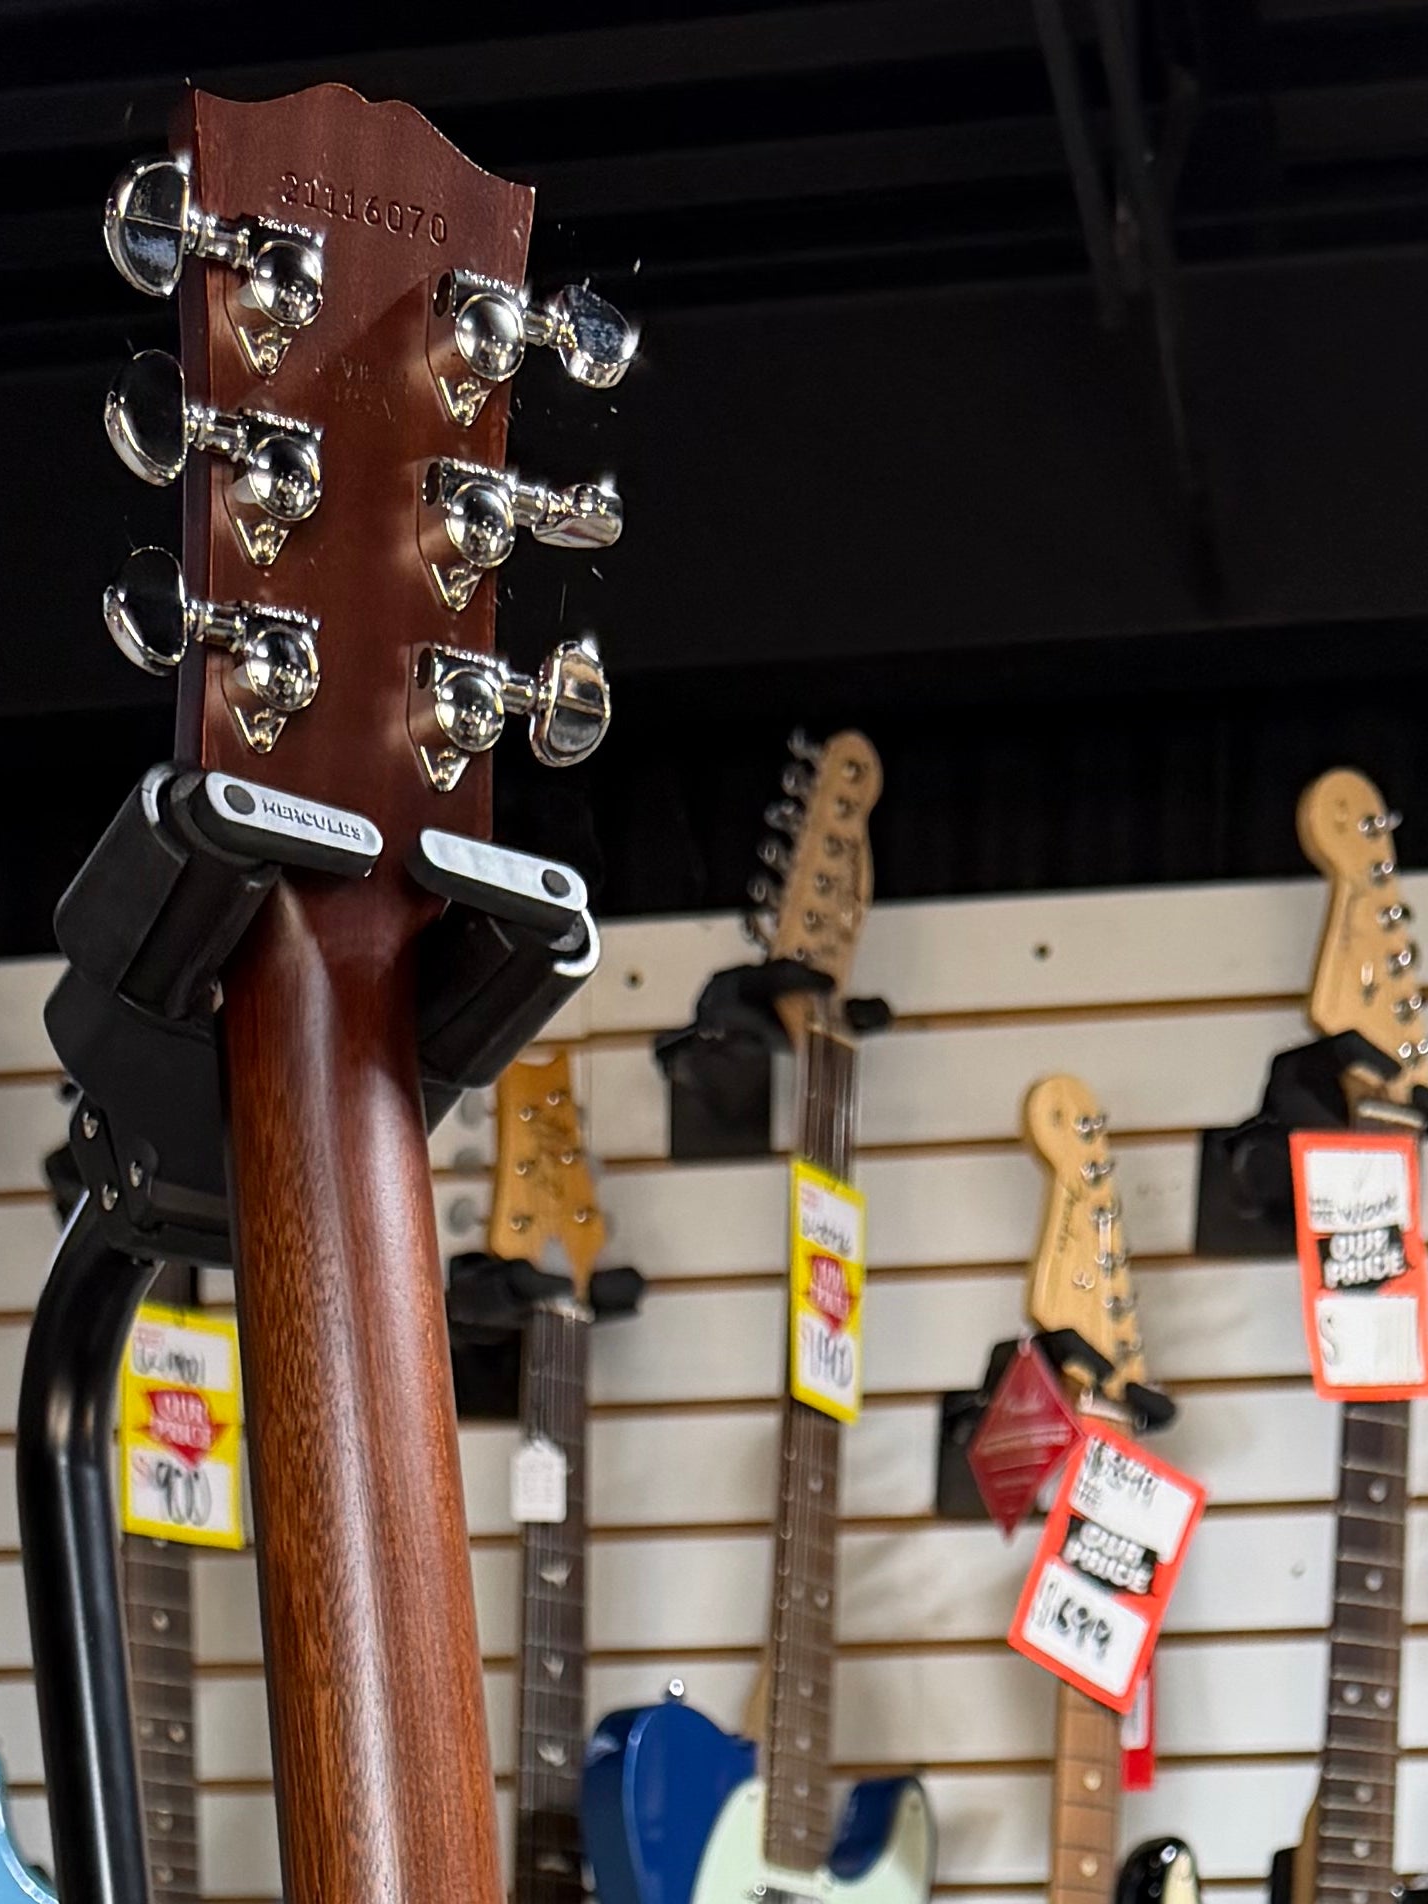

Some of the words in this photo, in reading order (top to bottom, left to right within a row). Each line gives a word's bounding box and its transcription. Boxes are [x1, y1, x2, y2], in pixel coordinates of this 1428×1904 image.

[280, 171, 447, 248] 21116070
[261, 797, 363, 842] HERCULES
[1322, 1245, 1406, 1290] PRICE
[1328, 1227, 1390, 1263] OUR
[1062, 1537, 1156, 1595] PRICE
[1078, 1521, 1145, 1567] OUR
